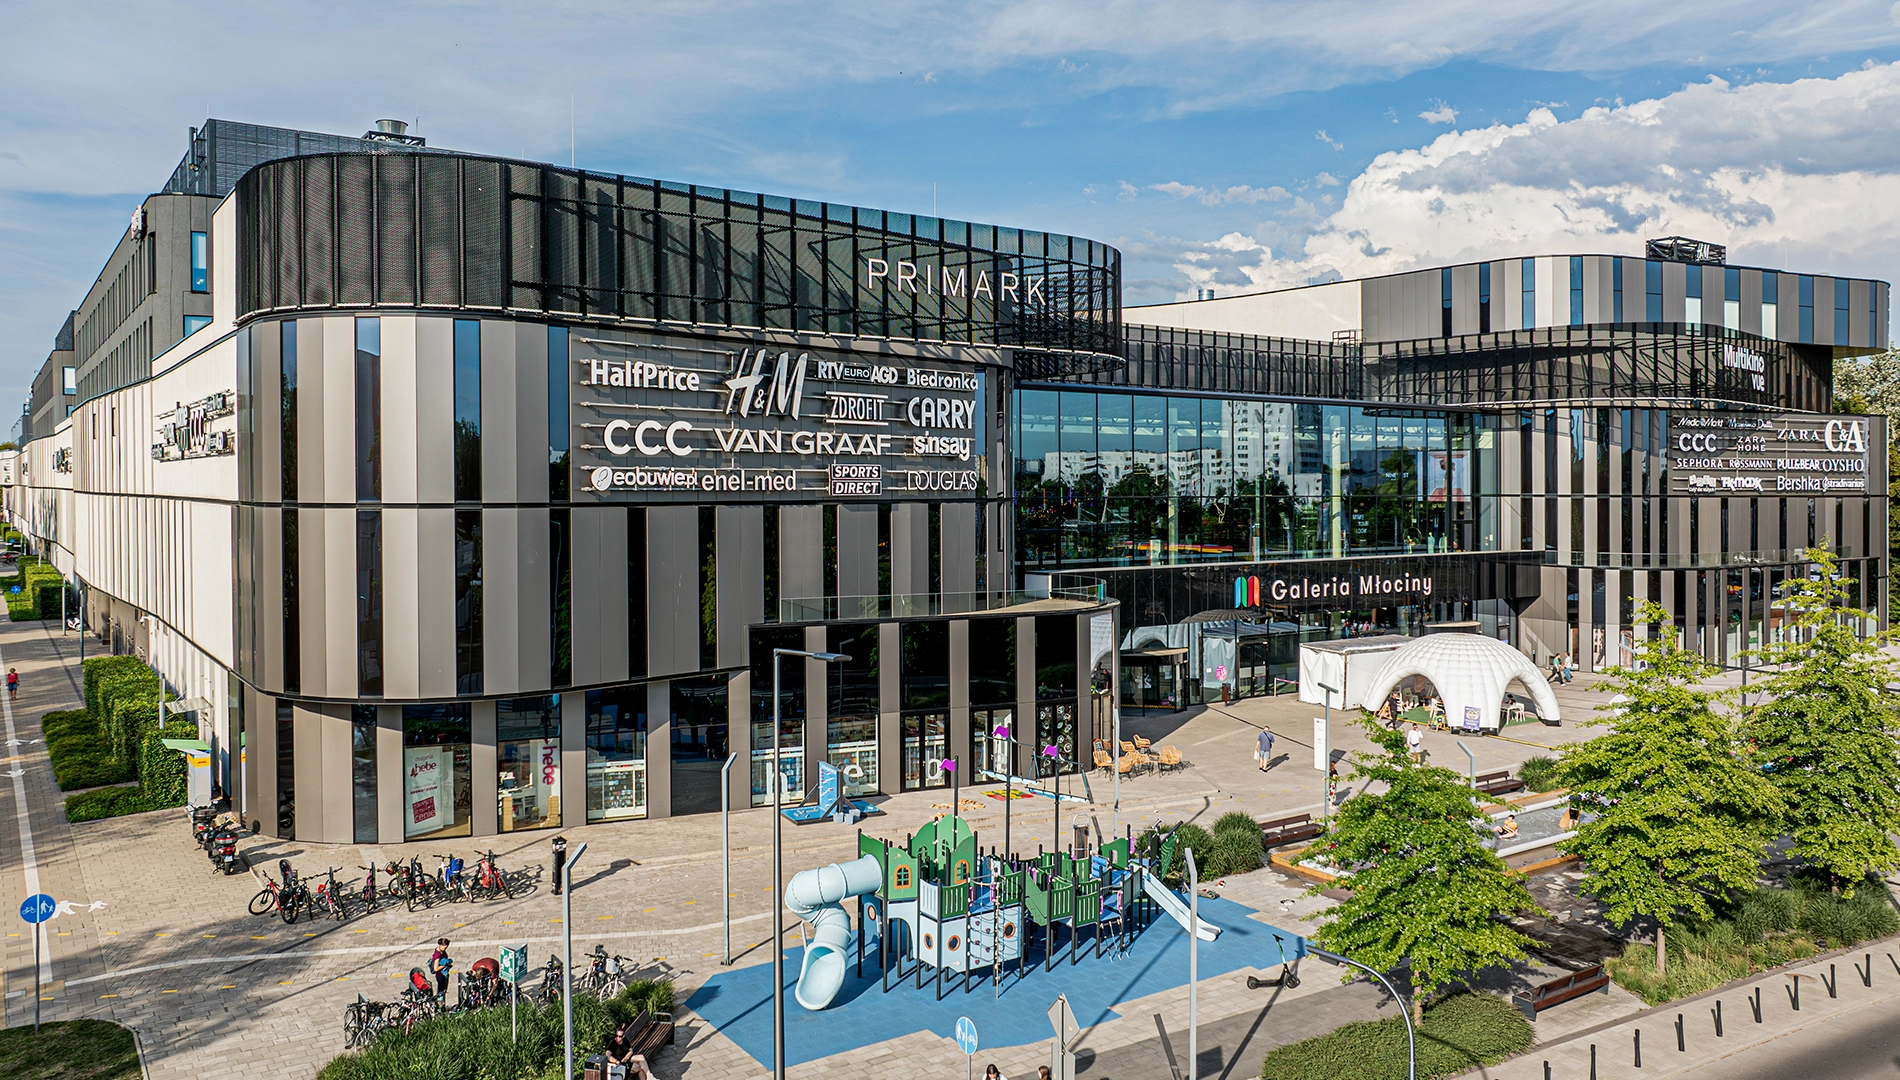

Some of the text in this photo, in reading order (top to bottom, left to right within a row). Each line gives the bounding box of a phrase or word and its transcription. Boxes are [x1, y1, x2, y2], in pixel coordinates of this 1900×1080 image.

[867, 257, 1046, 306] PRIMARK
[591, 359, 700, 391] HalfPrice
[817, 360, 899, 384] RTV EURO AGD
[907, 368, 979, 390] Biedronka
[725, 348, 808, 420] H&M
[830, 396, 885, 421] ZDROFIT
[907, 396, 977, 429] CARRY
[603, 419, 693, 456] CCC
[713, 428, 891, 455] VAN GRAAF
[1678, 432, 1717, 452] CCC
[1777, 429, 1820, 440] ZARA
[1824, 419, 1865, 452] C&A
[1738, 444, 1766, 452] HOME
[835, 465, 879, 478] SPORTS
[1677, 458, 1723, 468] SEPHORA
[1729, 459, 1773, 468] ROSSMANN
[1777, 458, 1820, 470] PULL&BEAR
[1822, 458, 1864, 472] OYSHO
[701, 469, 797, 491] enel-med
[835, 482, 880, 494] DIRECT
[907, 470, 978, 491] DOUGLAS
[1777, 475, 1820, 491] Bershka
[1271, 572, 1432, 601] Galeria Młociny
[414, 761, 437, 773] hebe
[542, 744, 558, 785] hebe
